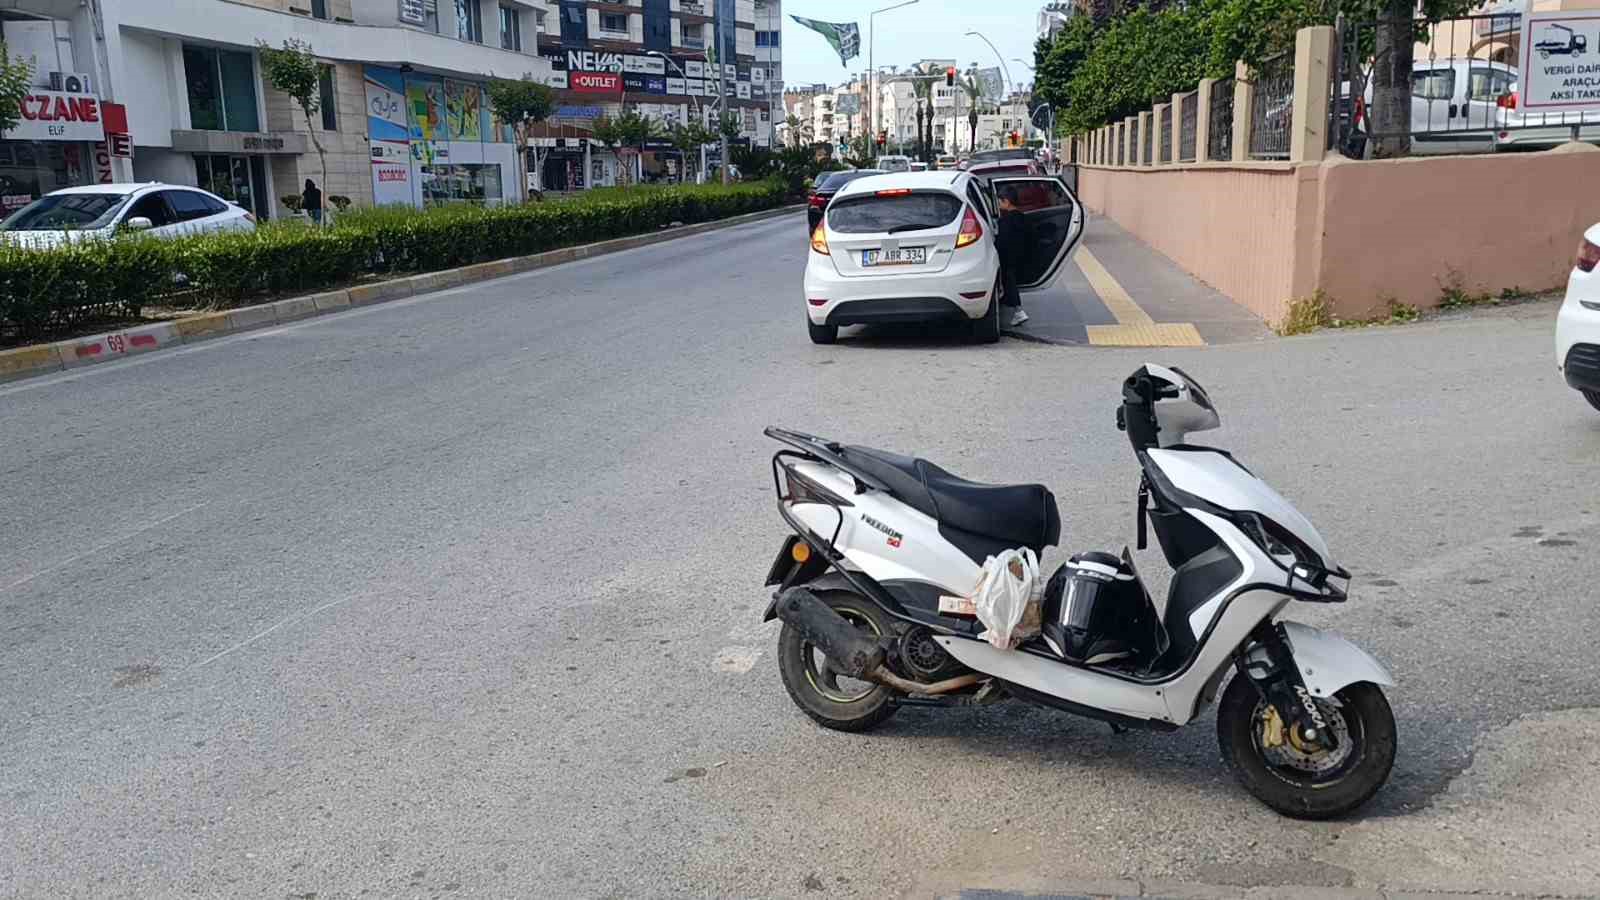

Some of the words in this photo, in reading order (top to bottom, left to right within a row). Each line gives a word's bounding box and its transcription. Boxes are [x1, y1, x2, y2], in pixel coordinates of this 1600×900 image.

[1544, 64, 1575, 75] VERGİ
[580, 76, 616, 88] OUTLET
[1550, 89, 1574, 100] AKSİ
[20, 95, 98, 122] CZANE
[906, 249, 922, 260] 334
[861, 513, 903, 540] FREEDOM
